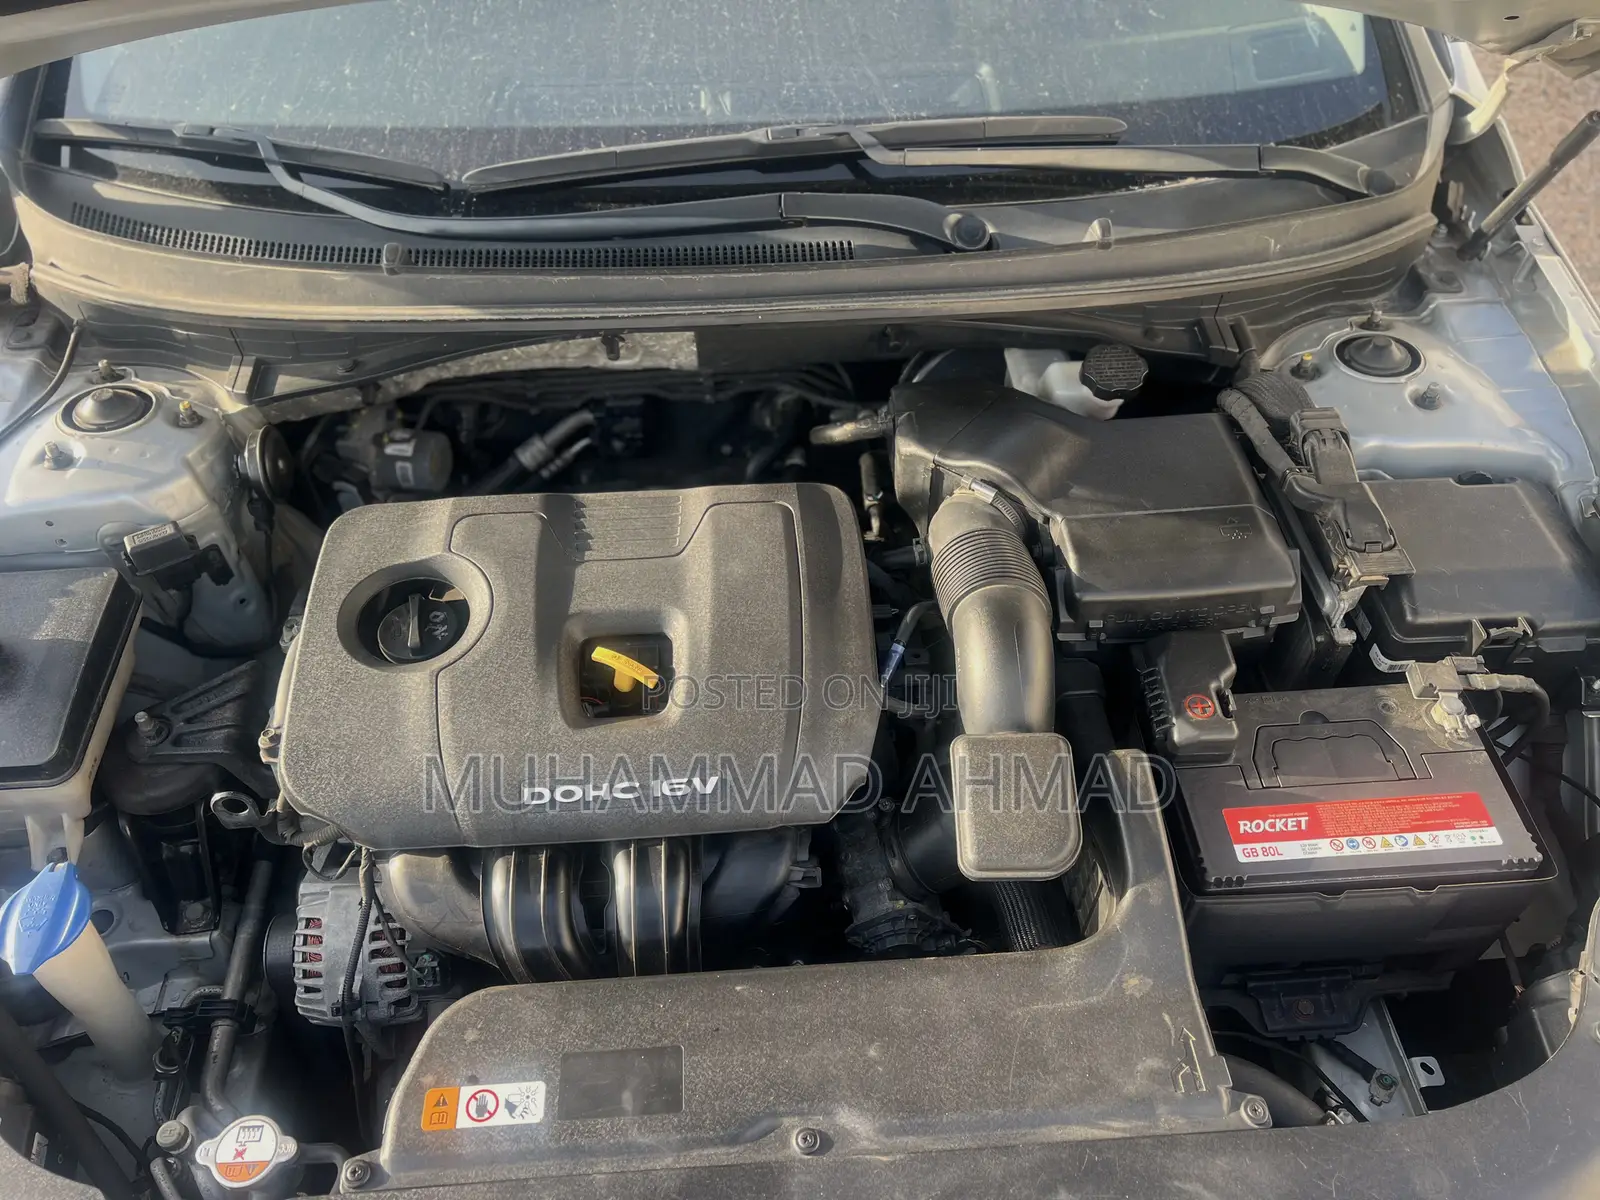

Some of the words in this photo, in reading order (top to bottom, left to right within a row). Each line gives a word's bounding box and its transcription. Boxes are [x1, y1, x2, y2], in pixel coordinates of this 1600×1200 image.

[523, 782, 640, 805] DOHC
[651, 776, 719, 797] 16V
[1238, 816, 1309, 834] ROCKET
[1242, 846, 1259, 858] GB
[1261, 845, 1283, 857] 80L
